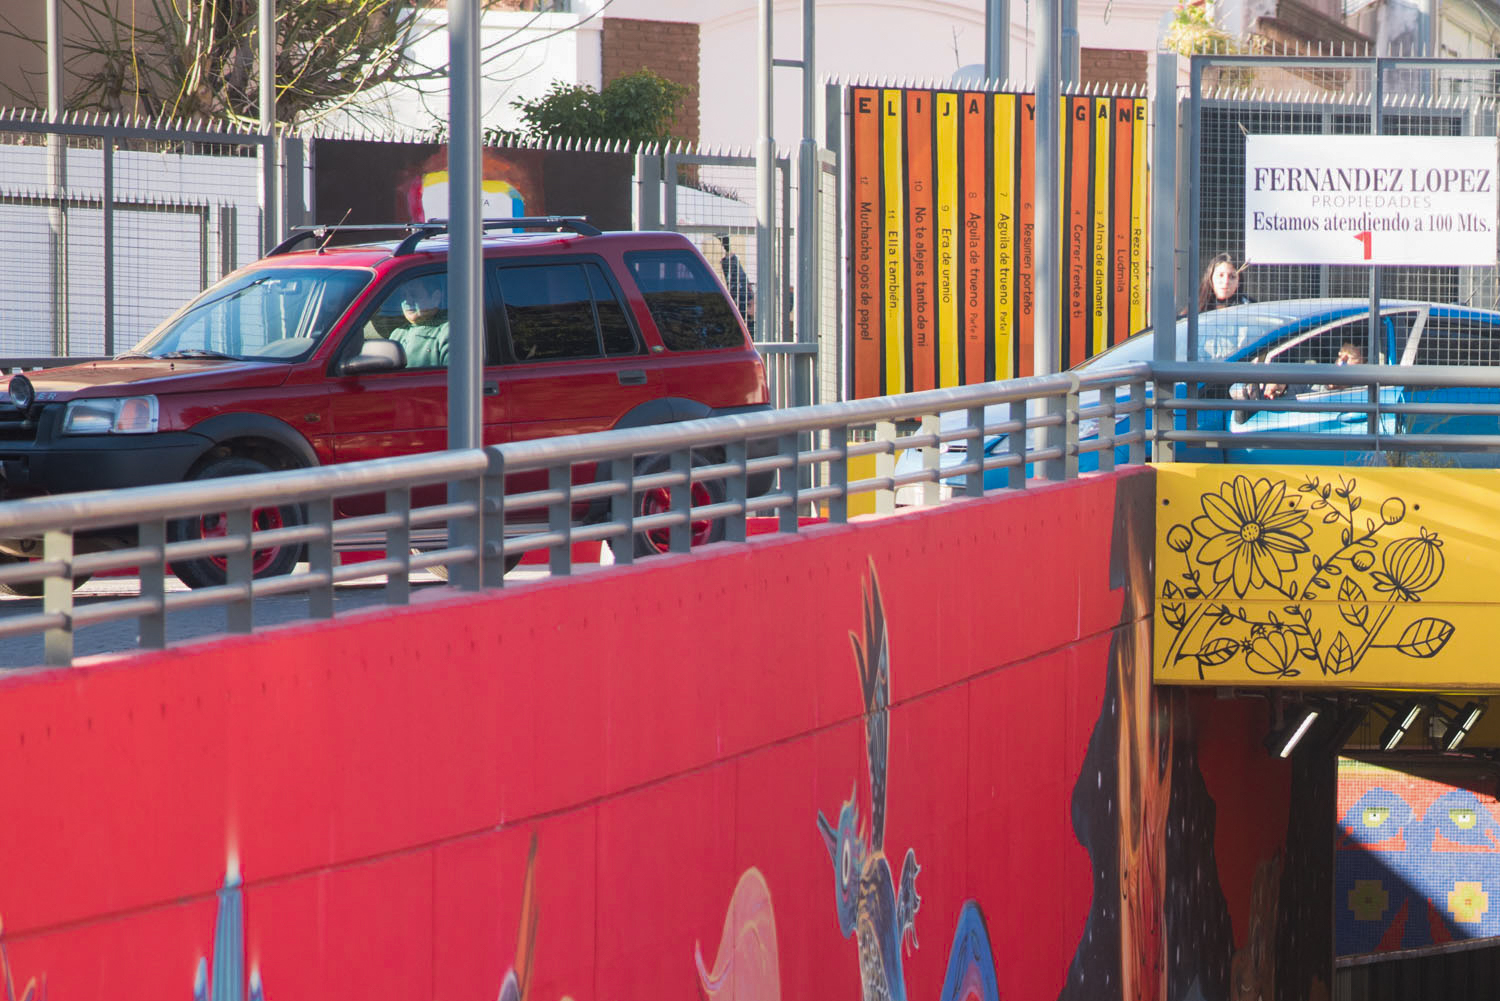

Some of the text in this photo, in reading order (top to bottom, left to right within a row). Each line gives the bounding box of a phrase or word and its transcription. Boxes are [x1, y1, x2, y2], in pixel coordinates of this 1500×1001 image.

[914, 181, 923, 192] 10
[1254, 167, 1491, 193] FERNANDEZ LOPEZ
[1312, 195, 1432, 208] PROPIEDADES
[915, 207, 926, 223] No
[1253, 211, 1491, 232] Estamos atendiendo a 100 Mts.
[860, 202, 872, 260] Muchacha
[888, 231, 898, 255] Ella
[915, 226, 927, 239] te
[942, 228, 952, 248] Era
[1073, 224, 1083, 261] Correr
[1096, 222, 1104, 251] Alma
[1133, 228, 1141, 256] Rezo
[913, 242, 927, 276] alejes
[942, 252, 952, 266] de
[970, 250, 980, 264] de
[1000, 252, 1009, 265] de
[1019, 202, 1034, 315] 6 Resumen porteño
[1096, 253, 1104, 266] de
[857, 264, 871, 289] ojos
[1073, 264, 1082, 298] frente
[1117, 249, 1127, 293] Ludmila
[1131, 261, 1139, 280] por
[916, 282, 928, 313] tanto
[942, 269, 951, 303] uranio
[969, 268, 980, 307] trueno
[1000, 268, 1009, 305] trueno
[1096, 269, 1104, 317] diamante
[861, 292, 872, 305] de
[857, 309, 872, 340] papel
[917, 315, 928, 330] de
[970, 312, 978, 334] Parte
[1000, 311, 1008, 331] Parte
